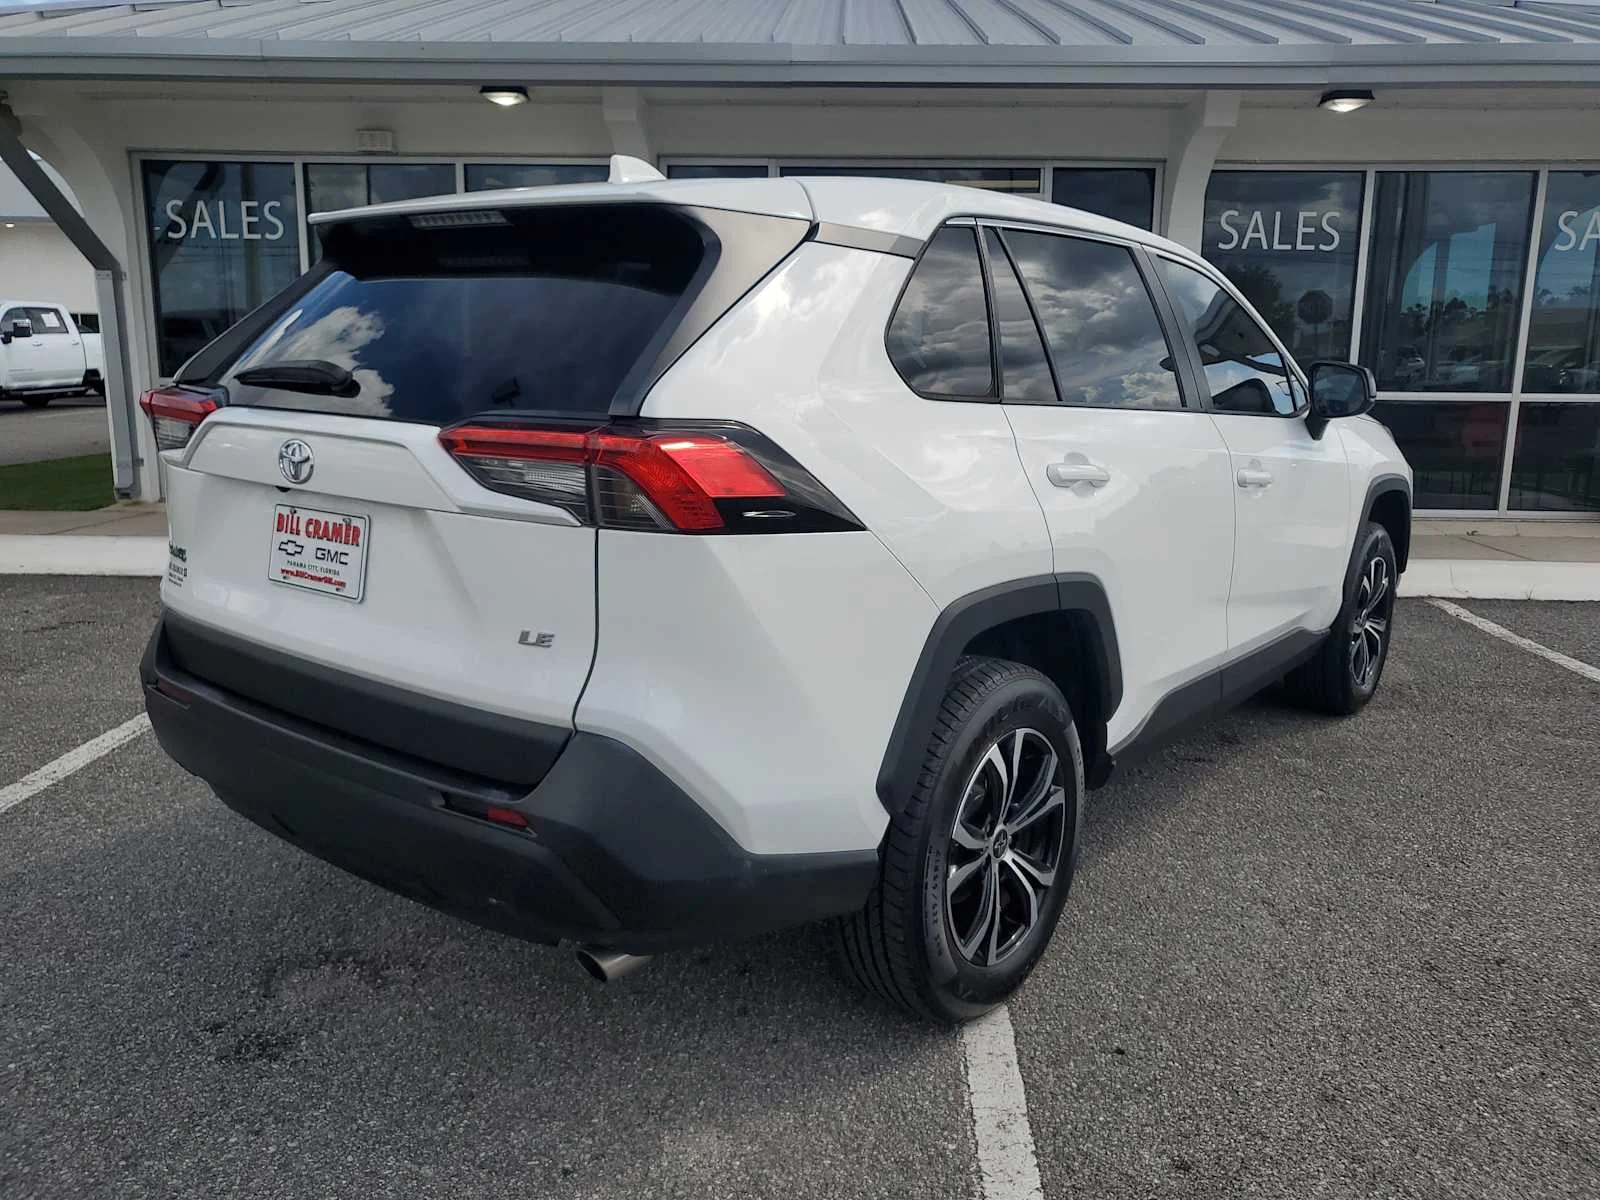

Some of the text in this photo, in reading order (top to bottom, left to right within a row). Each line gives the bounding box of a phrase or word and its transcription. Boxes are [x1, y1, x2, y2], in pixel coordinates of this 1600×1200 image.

[166, 199, 284, 240] SALES
[1217, 209, 1341, 252] SALES
[276, 512, 361, 547] BILL CRAMER
[315, 547, 349, 566] GMC
[518, 630, 555, 649] LE
